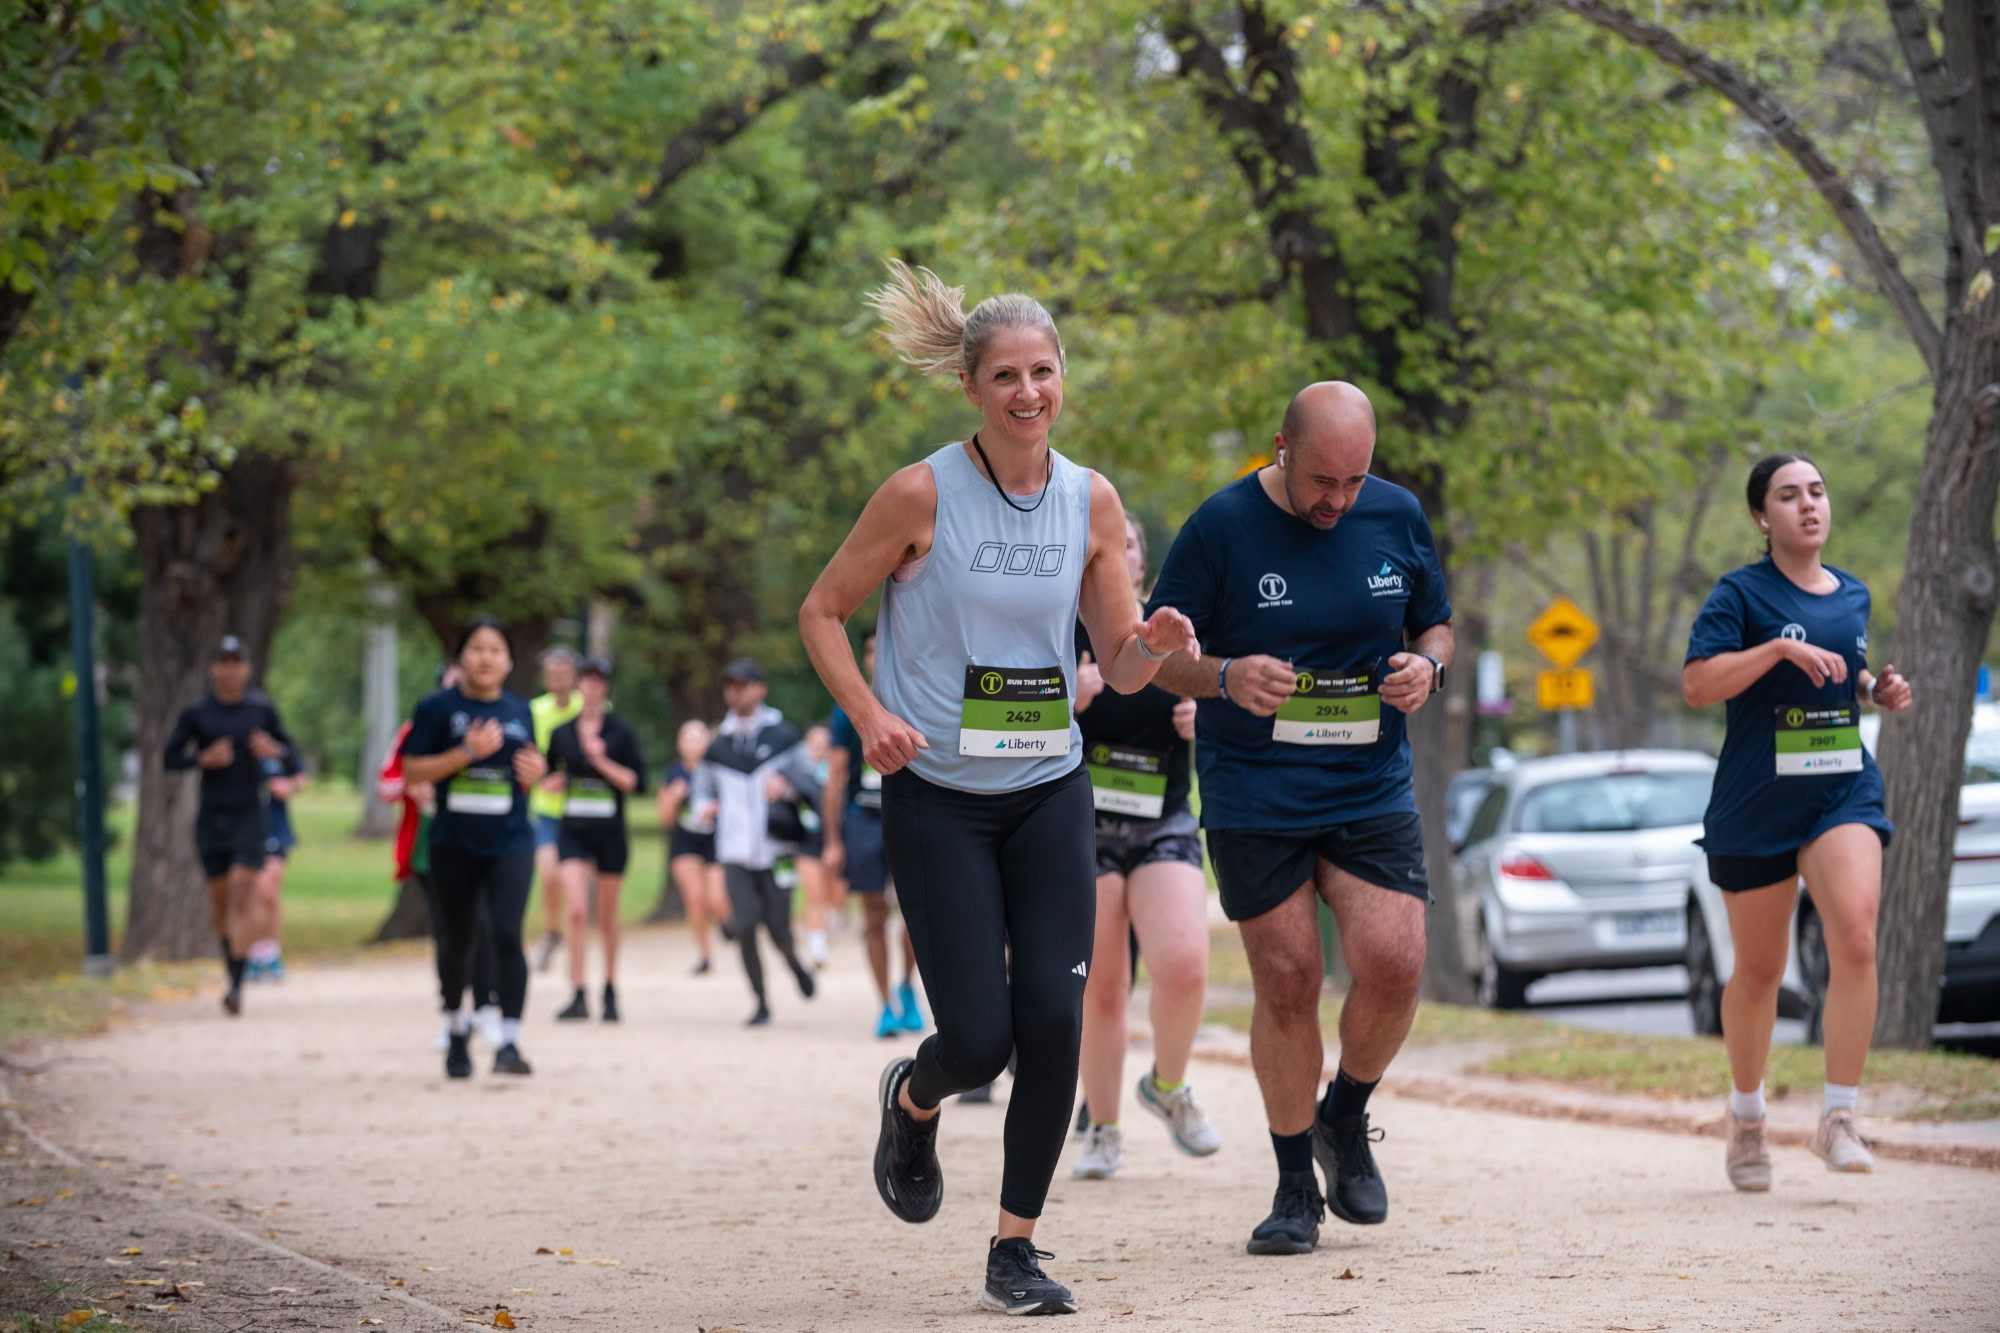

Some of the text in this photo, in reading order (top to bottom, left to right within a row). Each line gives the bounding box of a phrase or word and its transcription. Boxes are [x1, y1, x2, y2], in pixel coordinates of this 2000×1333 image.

[1367, 574, 1402, 589] Liberty
[1006, 710, 1040, 722] 2429
[1316, 706, 1348, 716] 2934
[1316, 729, 1352, 740] Liberty
[1008, 738, 1046, 752] Liberty
[1810, 735, 1836, 747] 2907
[1814, 758, 1842, 768] Liberty
